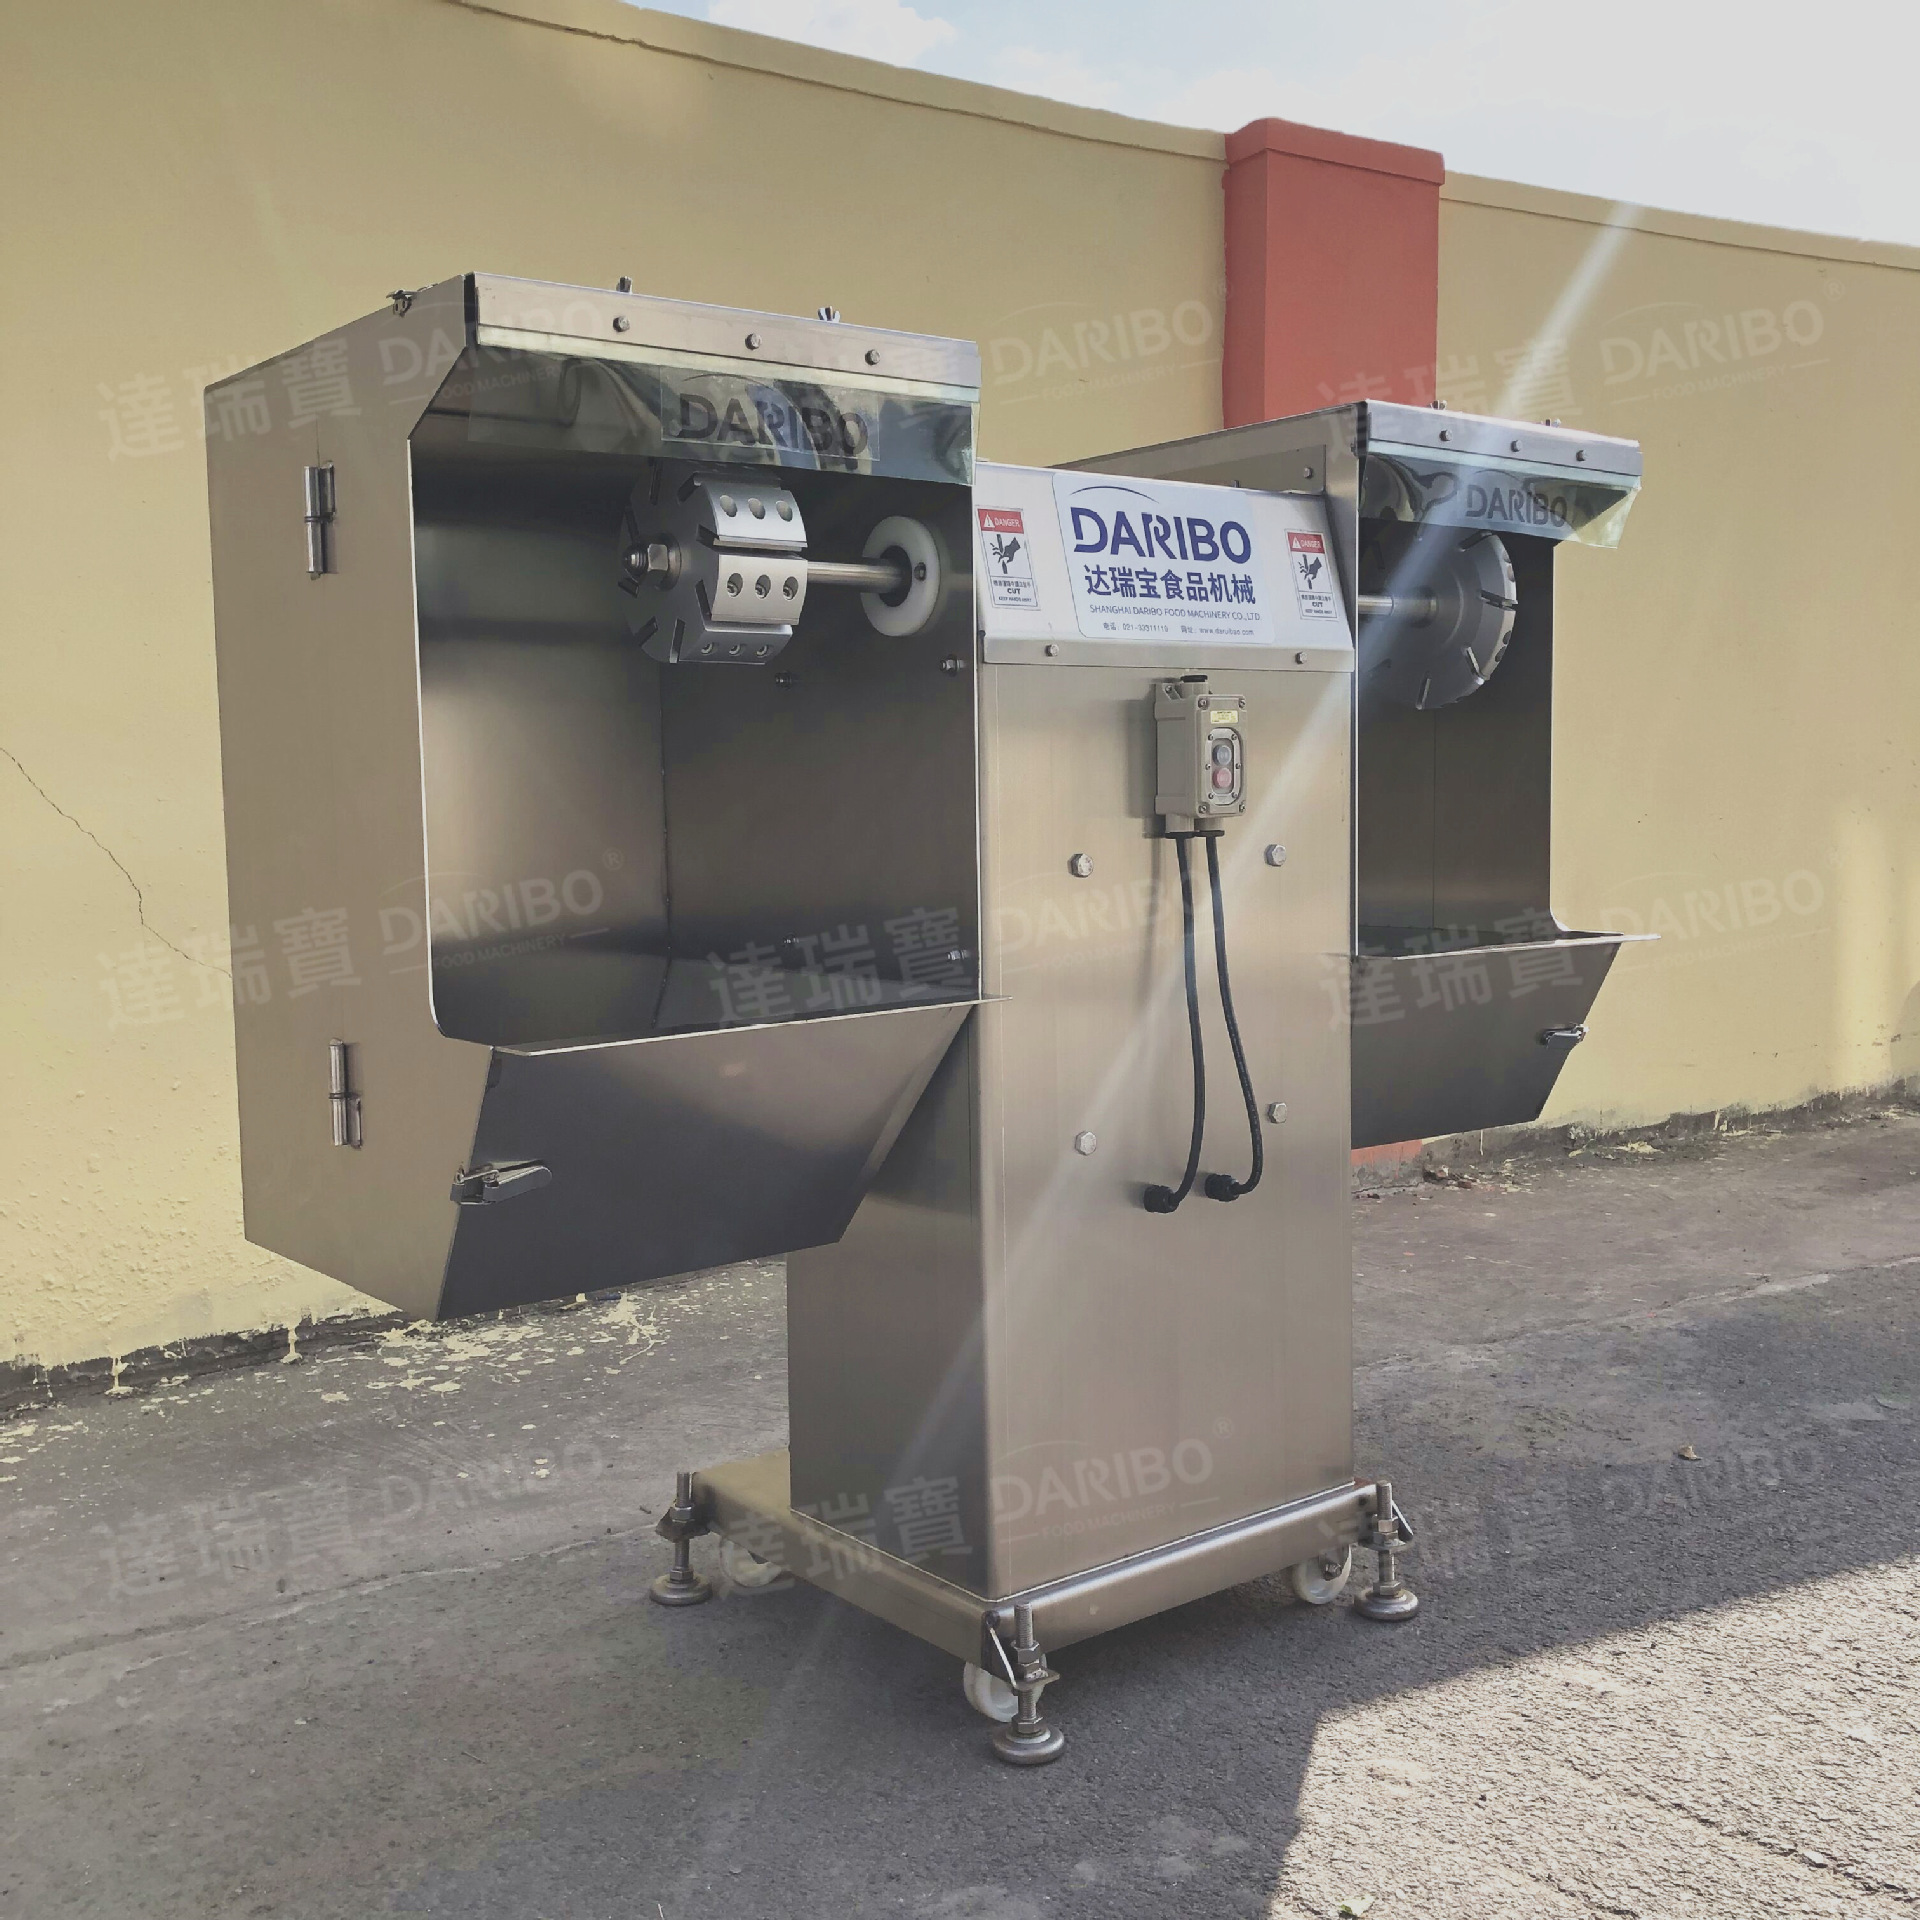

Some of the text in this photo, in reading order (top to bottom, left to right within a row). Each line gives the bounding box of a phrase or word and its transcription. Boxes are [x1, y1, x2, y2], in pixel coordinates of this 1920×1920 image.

[676, 393, 869, 456] DARIBO
[994, 517, 1020, 528] DANGER
[1465, 485, 1567, 527] DARIBO
[1070, 506, 1252, 564] DARIBO
[1300, 540, 1322, 549] DANGER
[1084, 563, 1257, 605] 达瑞宝食品机械
[1089, 604, 1132, 614] SHANGHAI
[1133, 606, 1163, 616] DARIBO
[1164, 608, 1186, 617] FOOD
[1187, 609, 1231, 619] MACHINERY
